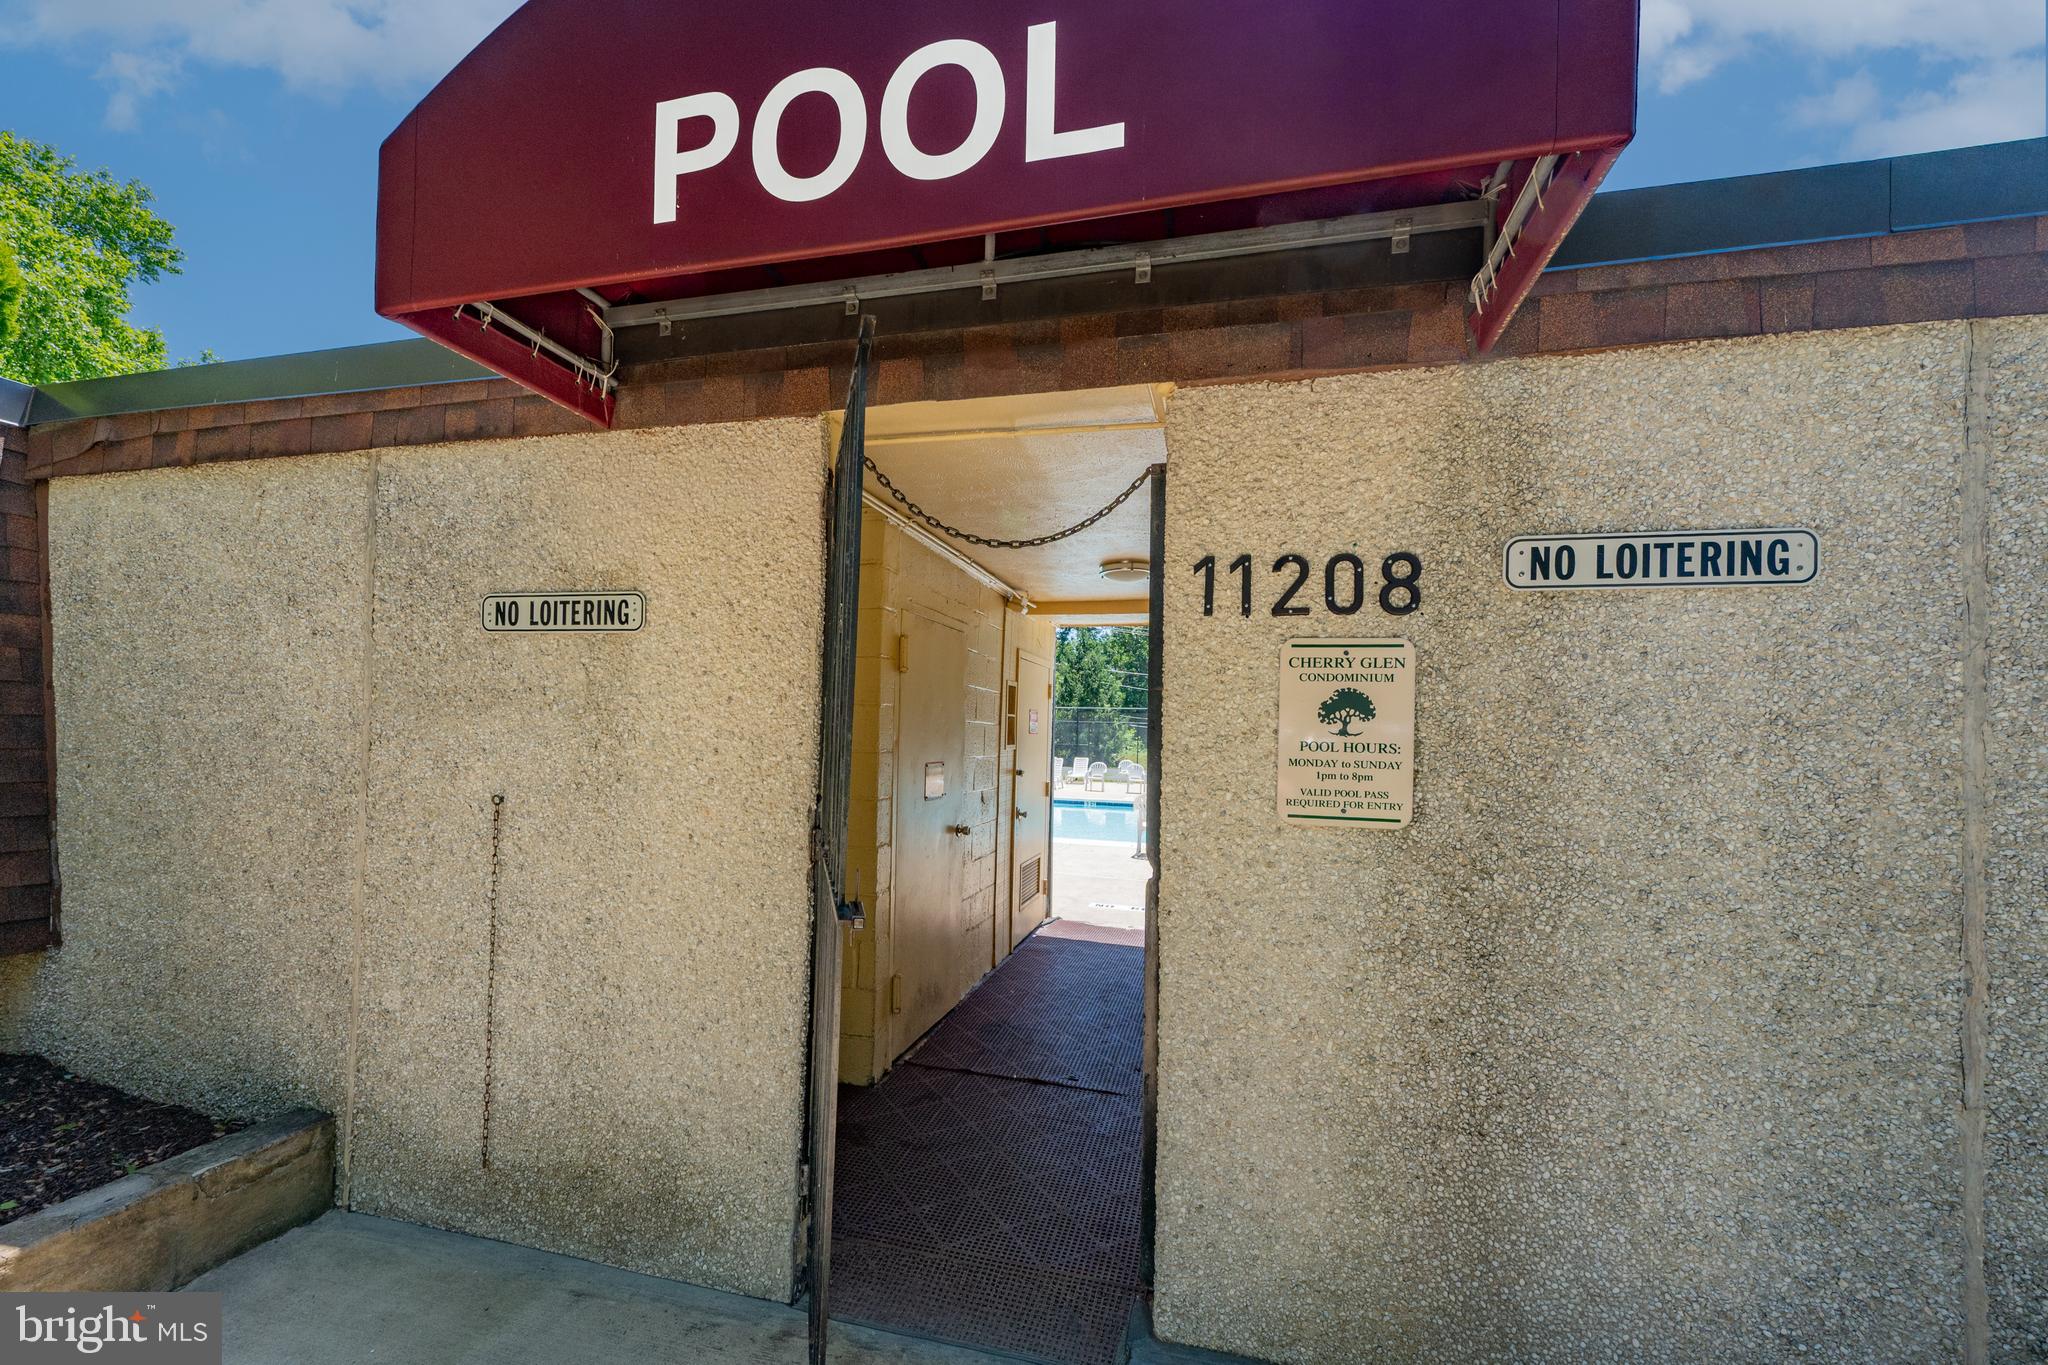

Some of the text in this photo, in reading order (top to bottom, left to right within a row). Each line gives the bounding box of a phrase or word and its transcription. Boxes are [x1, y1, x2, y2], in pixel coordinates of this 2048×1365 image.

[652, 20, 1126, 226] POOL
[1530, 537, 1790, 581] NO LOITERING
[1193, 551, 1423, 618] 11208
[494, 599, 630, 627] NO LOITERING
[1288, 656, 1406, 669] CHERRY GLEN
[1299, 672, 1395, 683] CONDOMINIUM
[1299, 740, 1401, 755] POOL HOURS:
[1288, 757, 1403, 770] MONDAY to SUNDAY
[1316, 771, 1374, 783] 1pm to 8pm
[1300, 787, 1390, 800] VALID POOL PASS
[1286, 798, 1404, 811] REQUIRED FOR ENTRY
